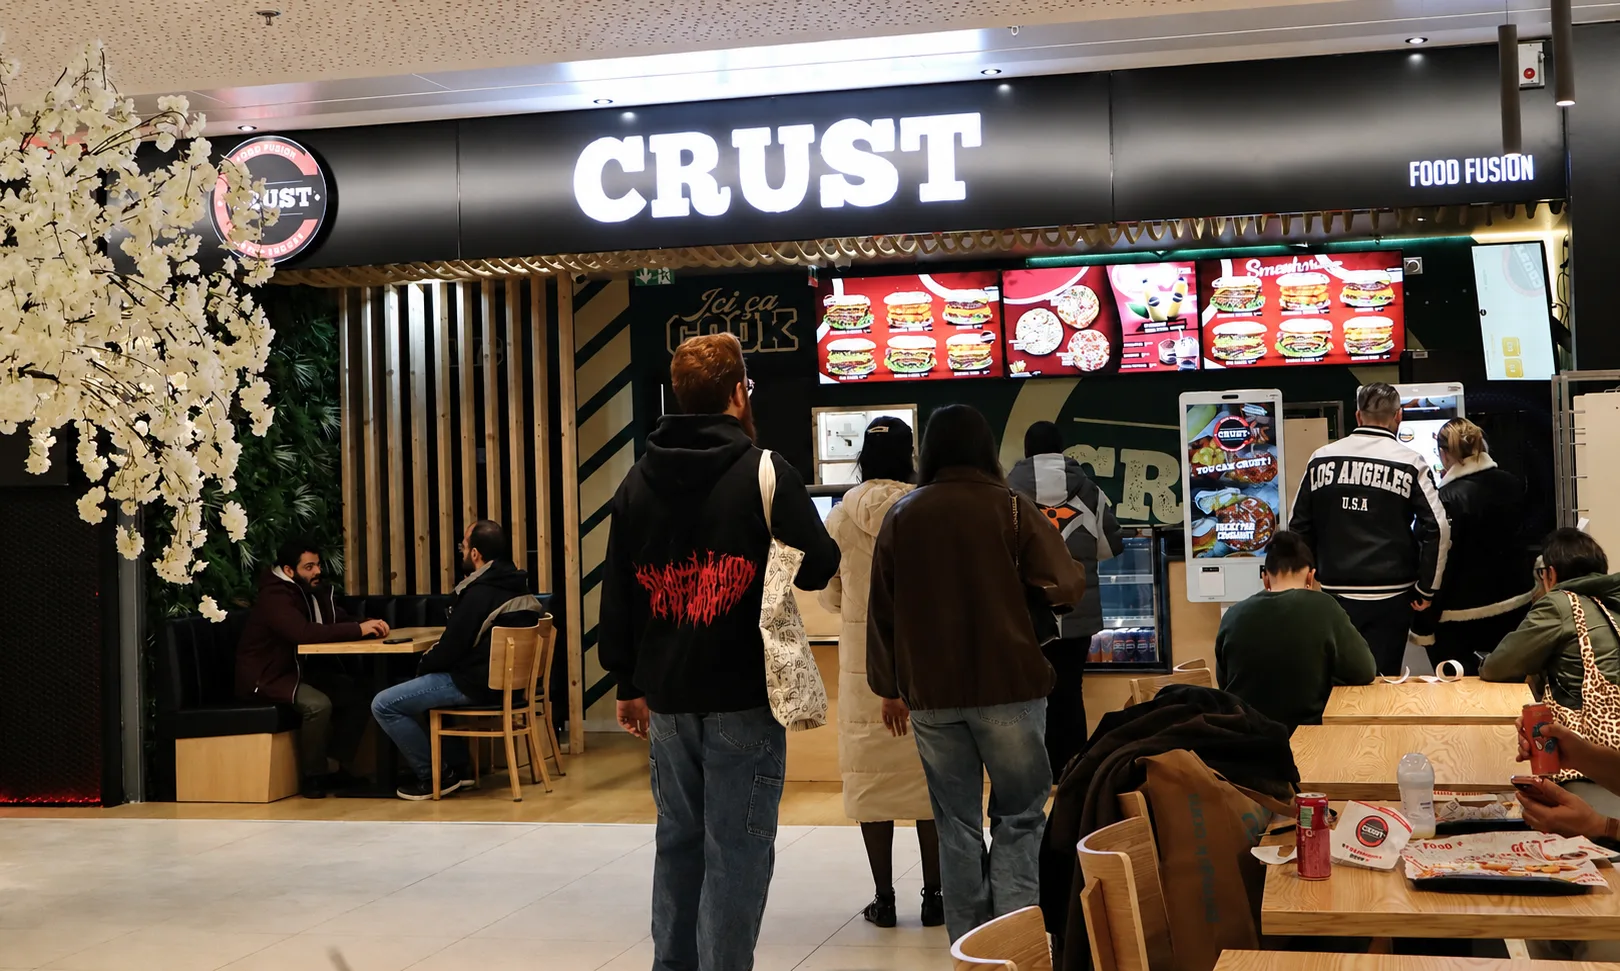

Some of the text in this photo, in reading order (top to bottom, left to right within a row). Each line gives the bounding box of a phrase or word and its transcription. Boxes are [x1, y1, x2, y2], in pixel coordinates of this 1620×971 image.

[263, 143, 296, 159] FUSION
[573, 112, 982, 223] CRUST
[1409, 154, 1534, 187] FOOD FUSION
[681, 287, 779, 322] Ici ça
[1196, 465, 1215, 475] YOU
[1215, 462, 1236, 472] CAN
[1310, 460, 1413, 499] LOS ANGELES
[1342, 496, 1368, 512] U.S.A
[1422, 842, 1453, 850] FOOD
